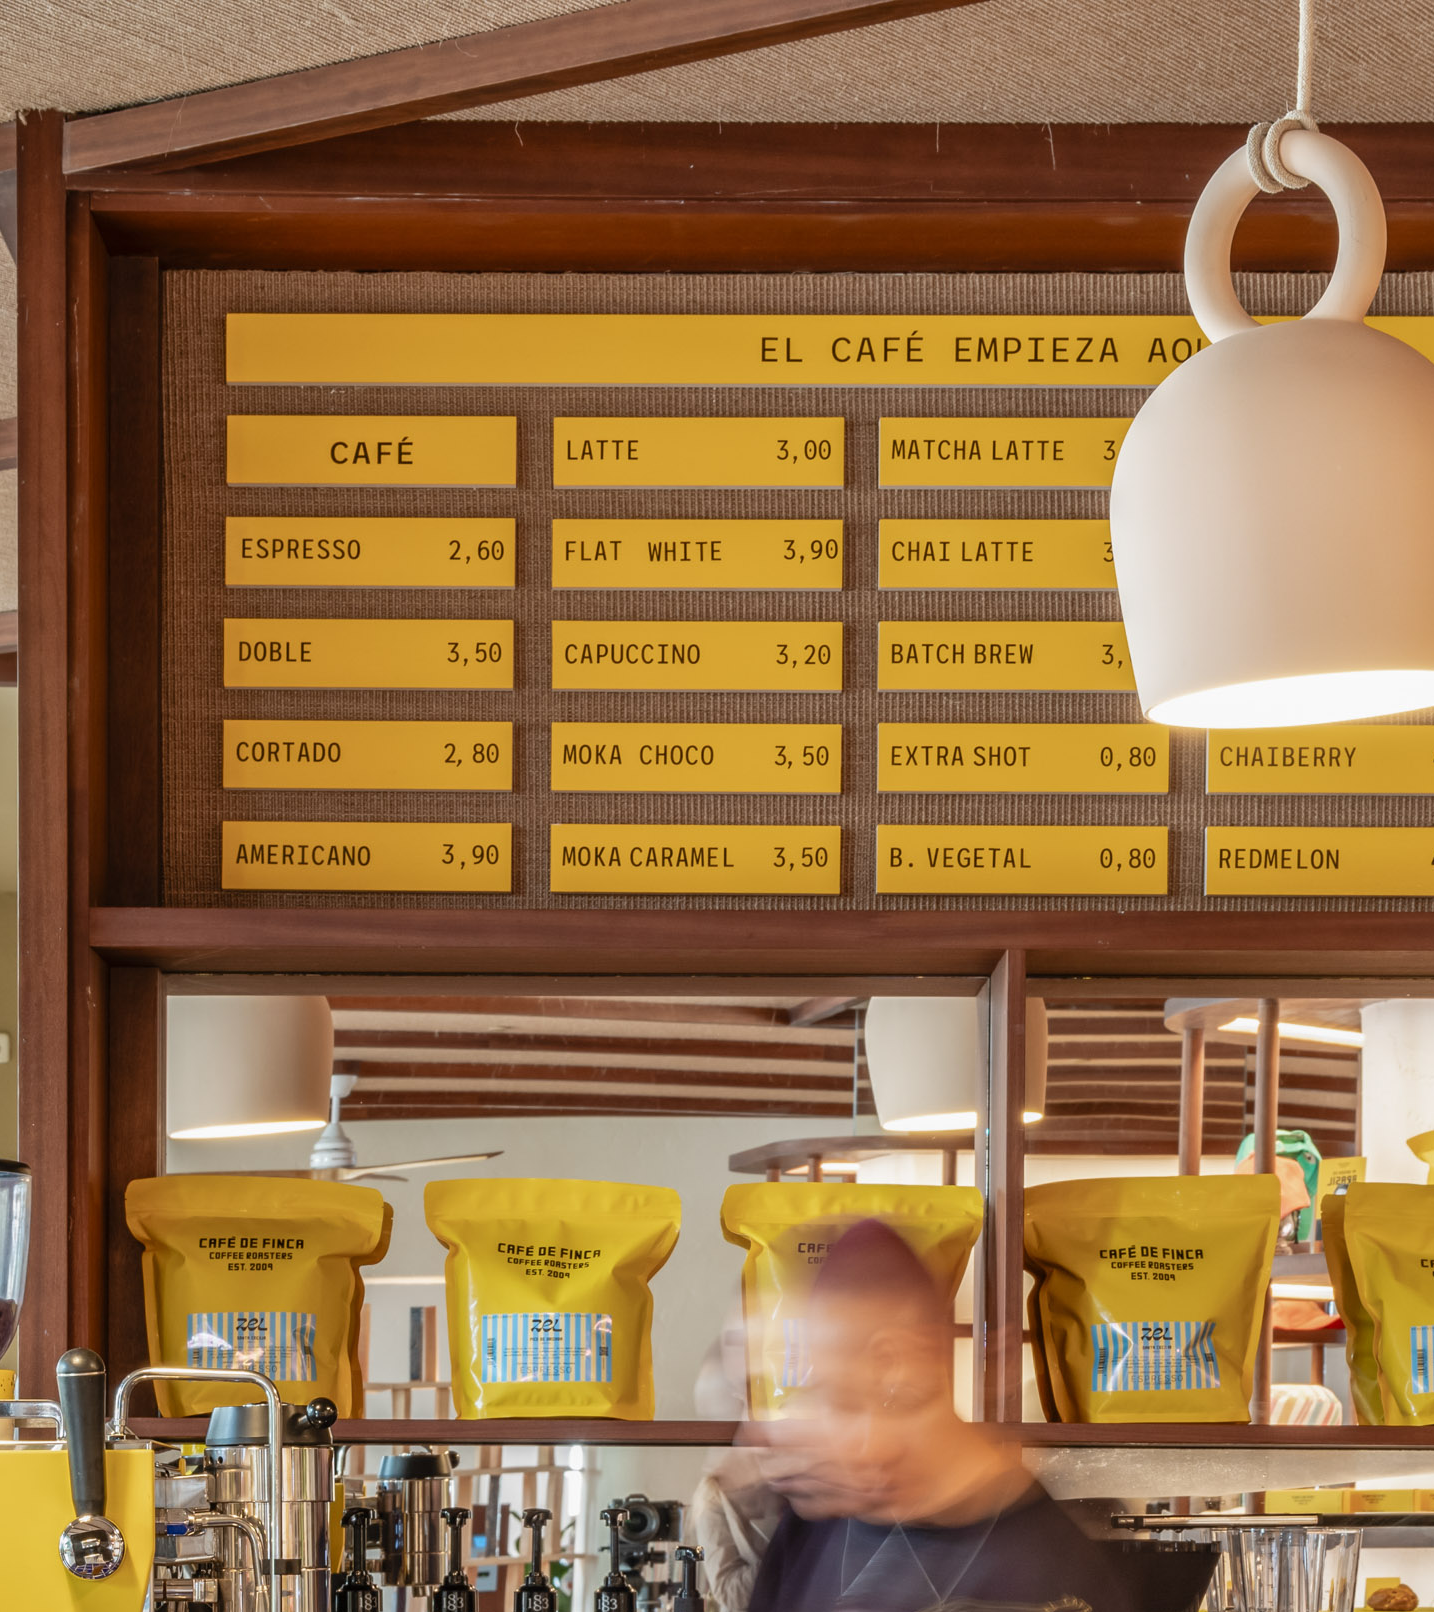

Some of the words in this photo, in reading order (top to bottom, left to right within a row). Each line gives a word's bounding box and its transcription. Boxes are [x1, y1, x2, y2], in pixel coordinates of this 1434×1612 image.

[761, 336, 803, 363] EL
[831, 330, 924, 363] CAFÉ
[955, 337, 1119, 363] EMPIEZA
[330, 435, 414, 465] CAFÉ
[567, 439, 639, 461] LATTE
[776, 439, 832, 464] 3,00
[891, 439, 982, 461] MATCHA
[992, 440, 1064, 461] LATTE
[241, 538, 361, 560] ESPRESSO
[449, 539, 505, 564] 2,60
[565, 540, 622, 561] FLAT
[647, 540, 722, 562] WHITE
[783, 538, 839, 564] 3,90
[891, 541, 950, 562] CHAI
[961, 541, 1034, 562] LATTE
[238, 641, 312, 663] DOBLE
[447, 642, 502, 667] 3,50
[564, 643, 701, 665] CAPUCCINO
[776, 644, 831, 669] 3,20
[891, 643, 965, 665] BATCH
[974, 643, 1034, 665] BREW
[236, 741, 341, 763] CORTADO
[444, 743, 500, 767] 2,80
[563, 744, 622, 765] MOKA
[639, 744, 714, 766] CHOCO
[774, 745, 829, 769] 3,50
[891, 745, 964, 766] EXTRA
[973, 745, 1031, 767] SHOT
[1100, 746, 1156, 772] 0,80
[1220, 746, 1356, 767] CHAIBERRY
[235, 843, 371, 867] AMERICANO
[441, 843, 499, 870] 3,90
[563, 846, 622, 867] MOKA
[629, 846, 735, 868] CARAMEL
[773, 847, 828, 872] 3,50
[890, 847, 914, 868] B.
[927, 847, 1033, 869] VEGETAL
[1100, 848, 1156, 872] 0,80
[1219, 848, 1340, 870] REDMELON
[199, 1236, 236, 1249] CAFÉ
[240, 1238, 258, 1248] DE
[262, 1238, 304, 1249] FINCA
[497, 1243, 534, 1256] CAFÉ
[538, 1246, 556, 1256] DE
[560, 1247, 601, 1260] FINCA
[1100, 1245, 1137, 1259] CAFÉ
[1141, 1246, 1158, 1258] DE
[1162, 1248, 1204, 1260] FINCA
[249, 1263, 273, 1271] 2009
[547, 1269, 570, 1279] 2009
[1153, 1273, 1176, 1281] 2009
